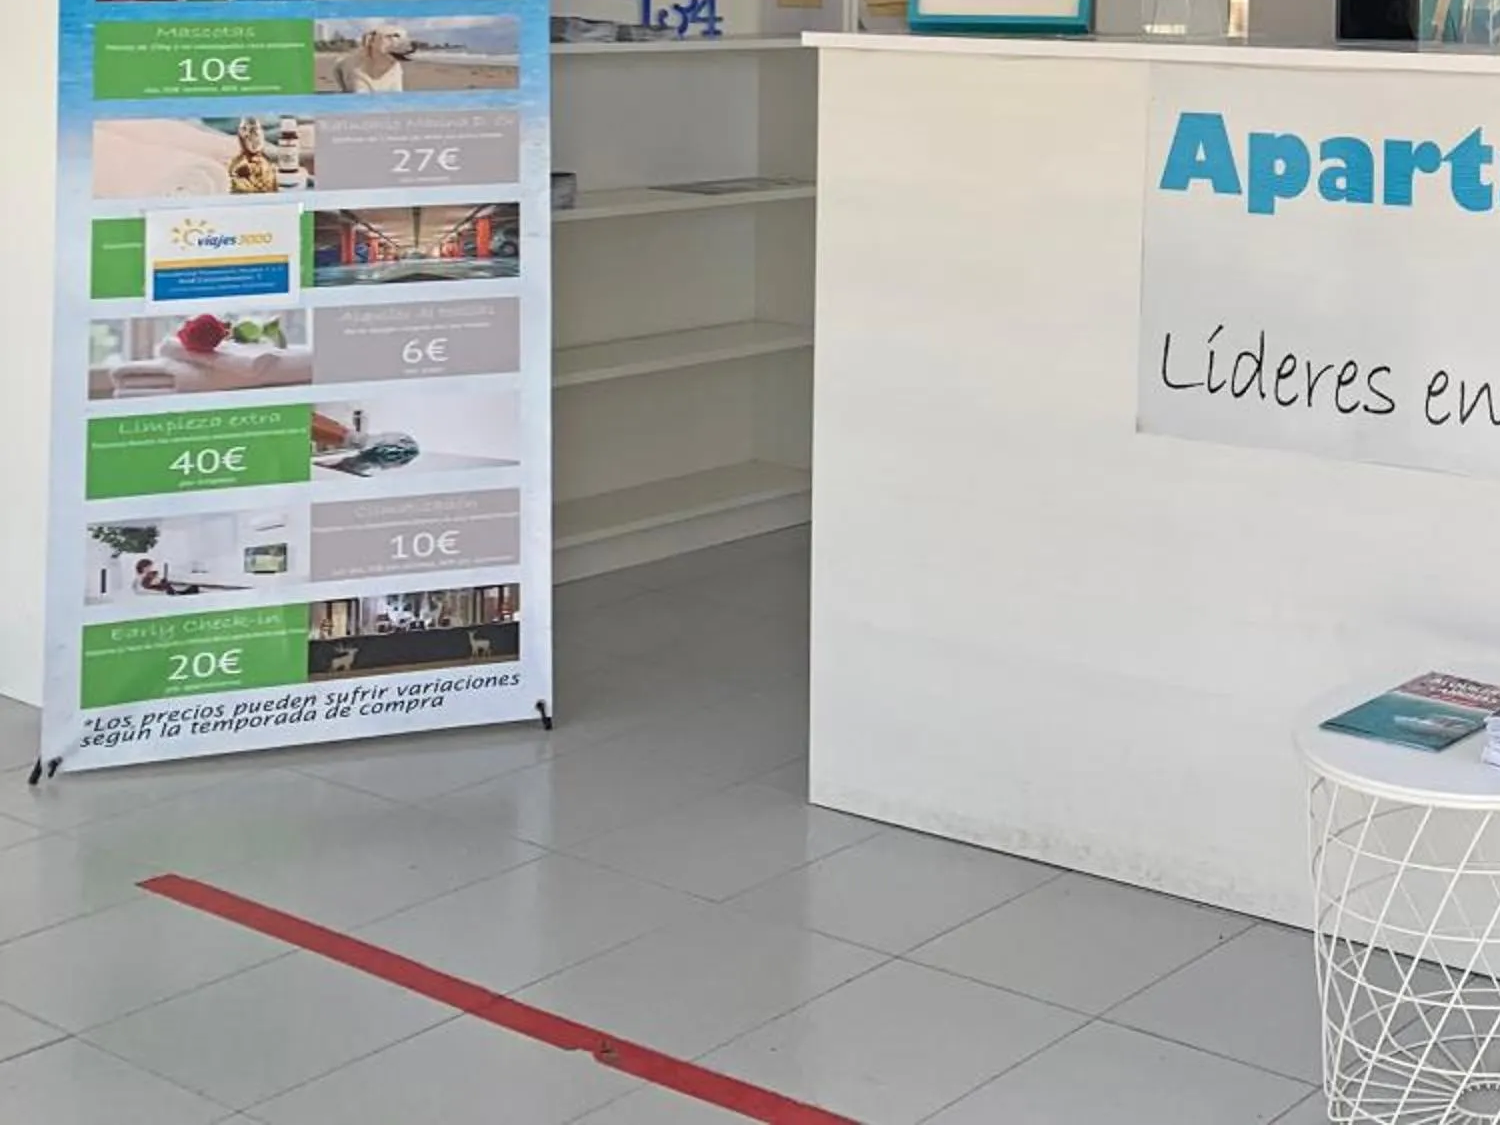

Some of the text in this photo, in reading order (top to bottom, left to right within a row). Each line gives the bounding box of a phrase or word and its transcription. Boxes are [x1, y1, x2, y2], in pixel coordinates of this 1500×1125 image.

[178, 57, 252, 82] 10€
[391, 147, 462, 173] 27€
[402, 337, 450, 364] 6€
[230, 411, 282, 426] extra
[169, 446, 247, 475] 40€
[390, 530, 461, 559] 10€
[168, 649, 243, 681] 20€
[140, 705, 224, 732] precios
[232, 694, 316, 721] pueden
[324, 683, 388, 709] sufrir
[396, 672, 521, 698] variaciones
[159, 721, 181, 738] la
[189, 708, 317, 737] temporada
[324, 701, 351, 720] de
[358, 694, 445, 719] compra
